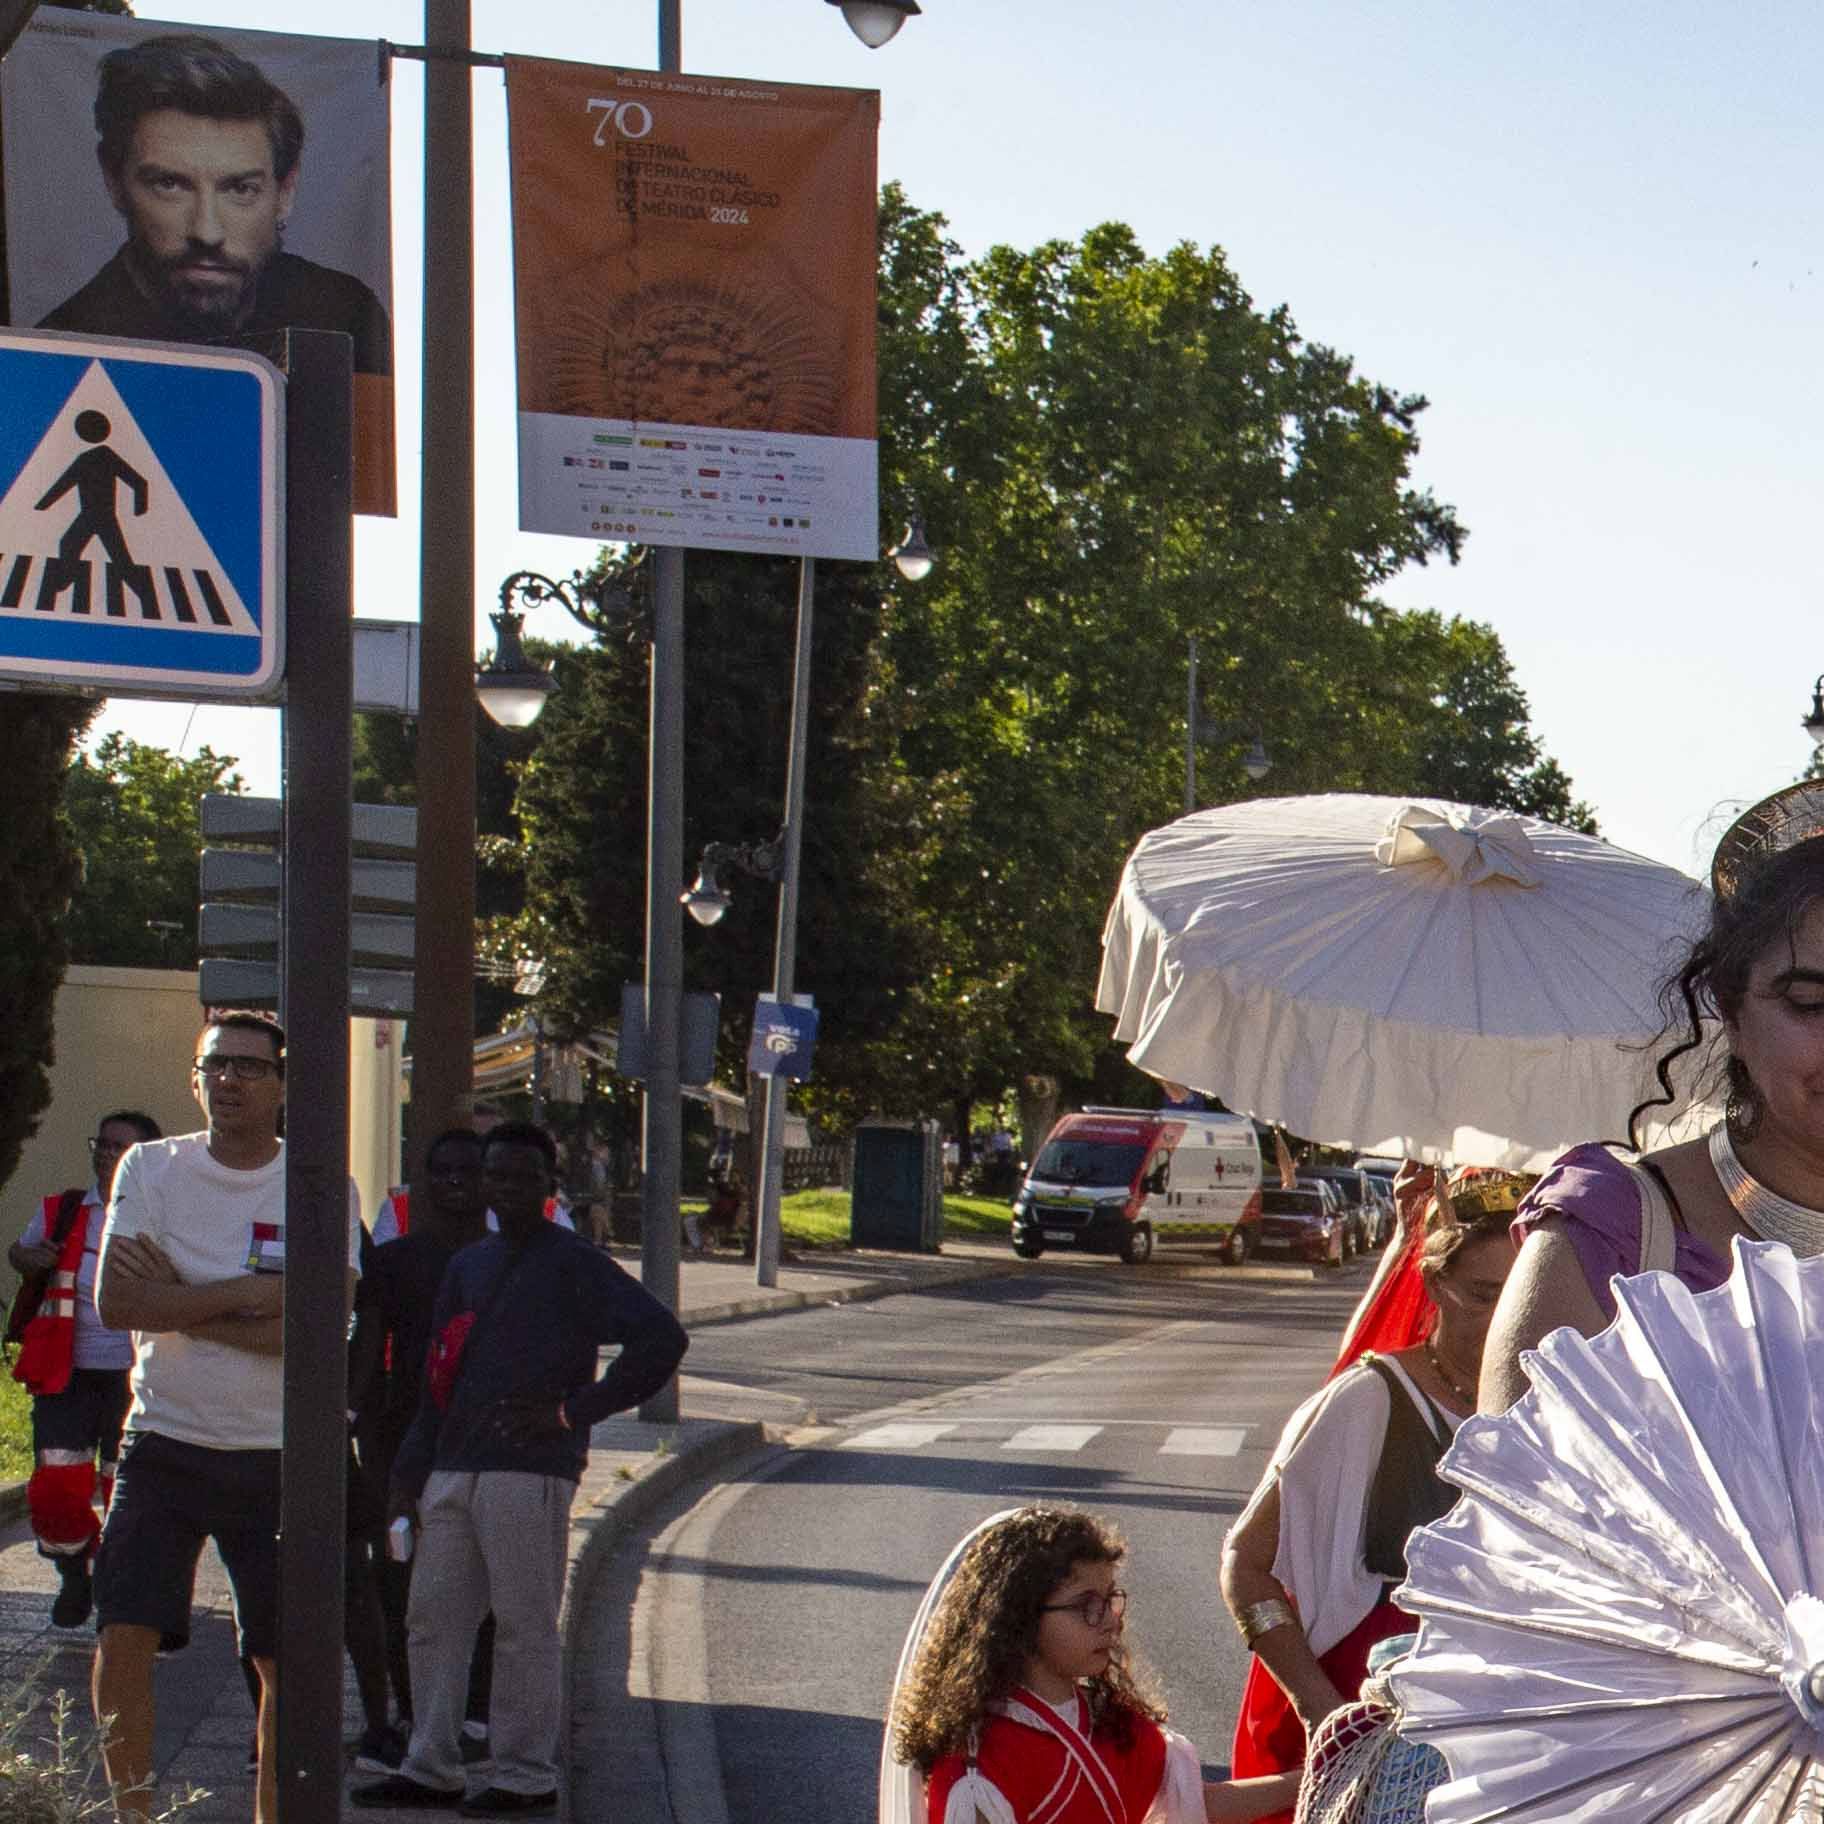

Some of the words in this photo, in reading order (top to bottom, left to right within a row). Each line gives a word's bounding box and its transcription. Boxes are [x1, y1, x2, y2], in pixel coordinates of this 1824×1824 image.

[585, 98, 654, 147] 70
[615, 143, 690, 162] FESTIVAL
[615, 158, 753, 187] INTERNACIONAL
[615, 177, 636, 197] DE
[640, 181, 705, 201] TEATRO
[709, 186, 781, 209] CLÁSICO
[615, 197, 636, 214] DE
[640, 199, 706, 219] MÉRIDA
[710, 207, 750, 226] 2024
